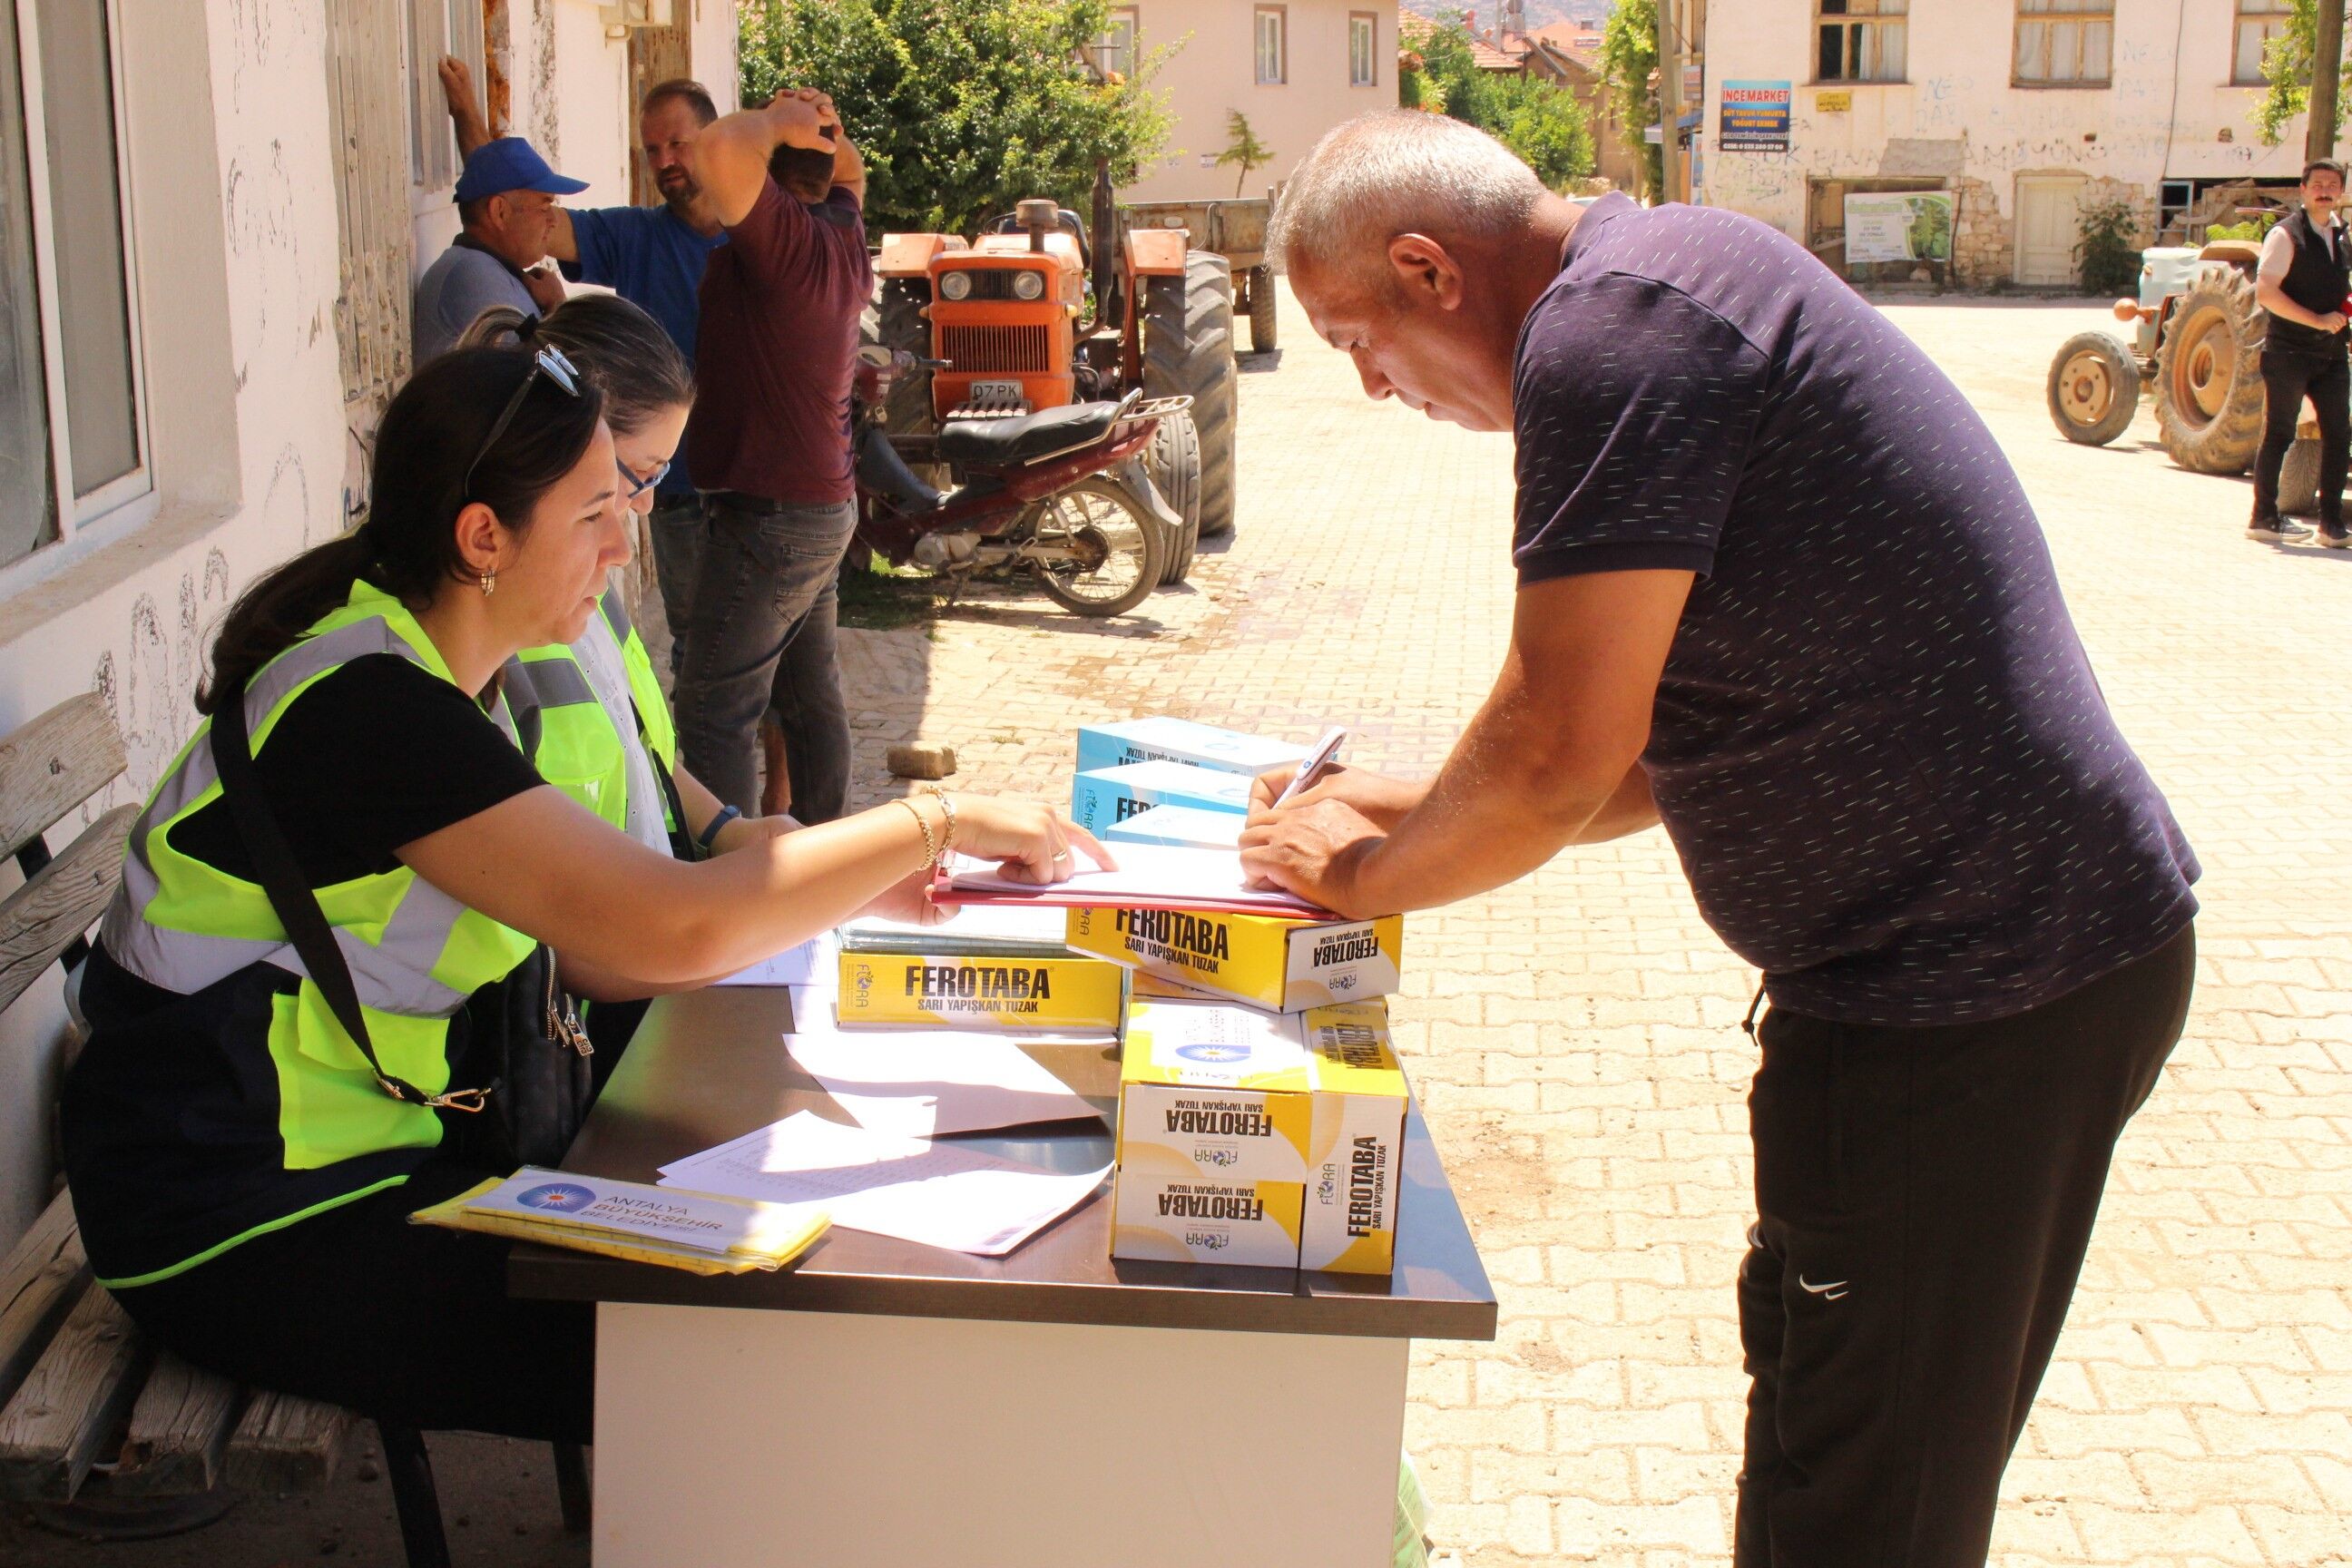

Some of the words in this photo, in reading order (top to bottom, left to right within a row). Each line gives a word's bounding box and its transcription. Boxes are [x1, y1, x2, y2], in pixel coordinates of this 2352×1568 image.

[1748, 90, 1788, 102] MARKET
[1116, 908, 1229, 961] FEROTABA
[1124, 936, 1144, 953] SARI
[1147, 942, 1190, 965] YAPIŞKAN
[1192, 955, 1219, 974] TUZAK
[1314, 936, 1378, 967] FEROTABA
[906, 965, 1050, 999] FEROTABA
[917, 999, 943, 1011] SARI
[947, 1000, 1001, 1014] YAPIŞKAN
[1005, 1001, 1038, 1013] TUZAK
[1175, 1100, 1200, 1109] TUZAK
[1202, 1100, 1241, 1112] YAPIŞKAN
[1244, 1103, 1263, 1112] SARI
[1166, 1110, 1272, 1137] FEROTABA
[1376, 1145, 1387, 1169] TUZAK
[1167, 1184, 1191, 1193] TUZAK
[1194, 1183, 1233, 1196] YAPIŞKAN
[1236, 1188, 1255, 1197] SARI
[1348, 1136, 1377, 1238] FEROTABA
[1374, 1171, 1387, 1209] YAPIŞKAN
[604, 1196, 690, 1215] ANTALYA
[1158, 1193, 1264, 1221] FEROTABA
[1373, 1210, 1382, 1229] SARI
